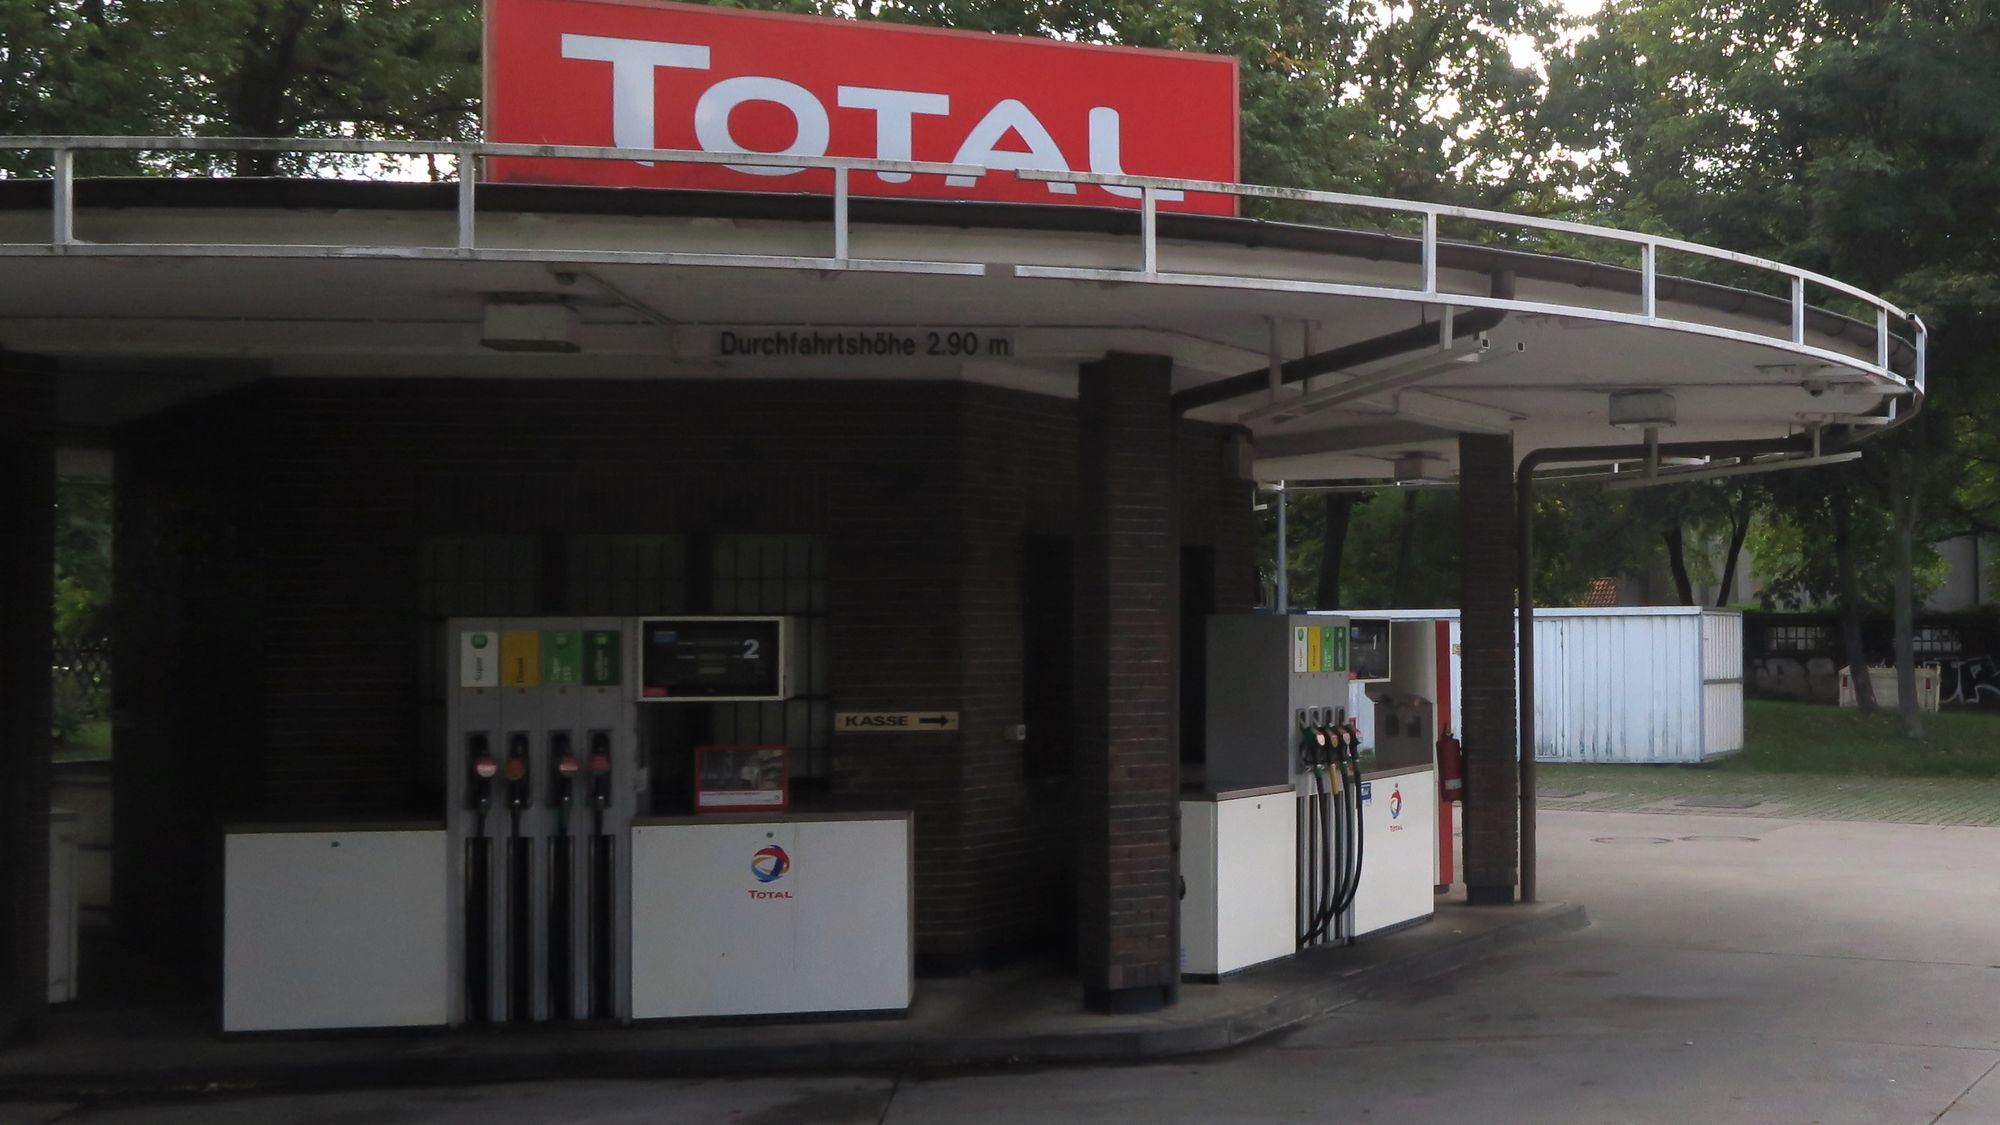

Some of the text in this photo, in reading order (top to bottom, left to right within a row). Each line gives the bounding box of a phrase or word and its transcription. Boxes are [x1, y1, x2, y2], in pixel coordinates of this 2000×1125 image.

[561, 33, 1184, 202] TOTAL
[720, 331, 1009, 355] Durchfahrtshöhe 2.90 m
[743, 639, 760, 660] 2
[845, 716, 910, 727] KASSE
[747, 890, 793, 900] TOTAL
